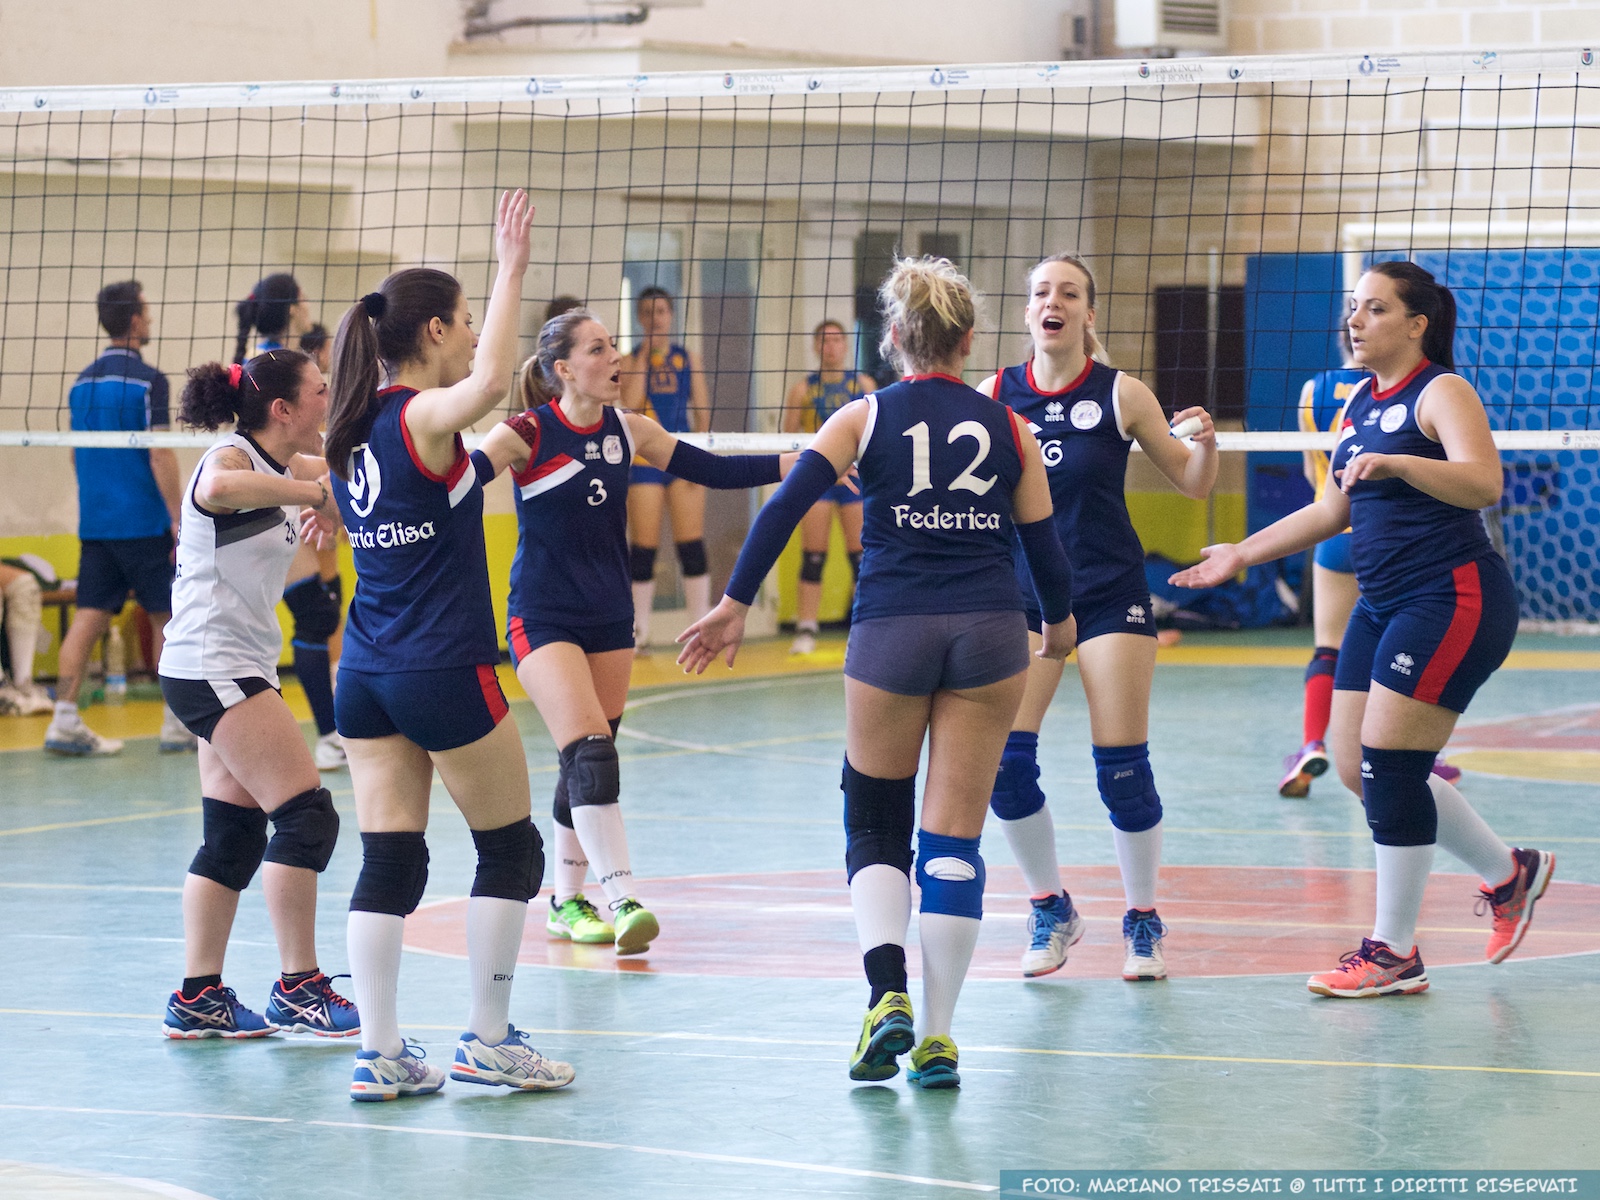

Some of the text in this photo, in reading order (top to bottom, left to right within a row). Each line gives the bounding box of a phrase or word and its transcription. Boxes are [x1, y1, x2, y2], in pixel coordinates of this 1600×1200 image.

[902, 420, 999, 497] 12
[1036, 438, 1064, 468] 6
[347, 442, 381, 518] 9
[587, 478, 608, 507] 3
[890, 504, 1001, 530] Federica
[344, 521, 436, 549] aria Elisa
